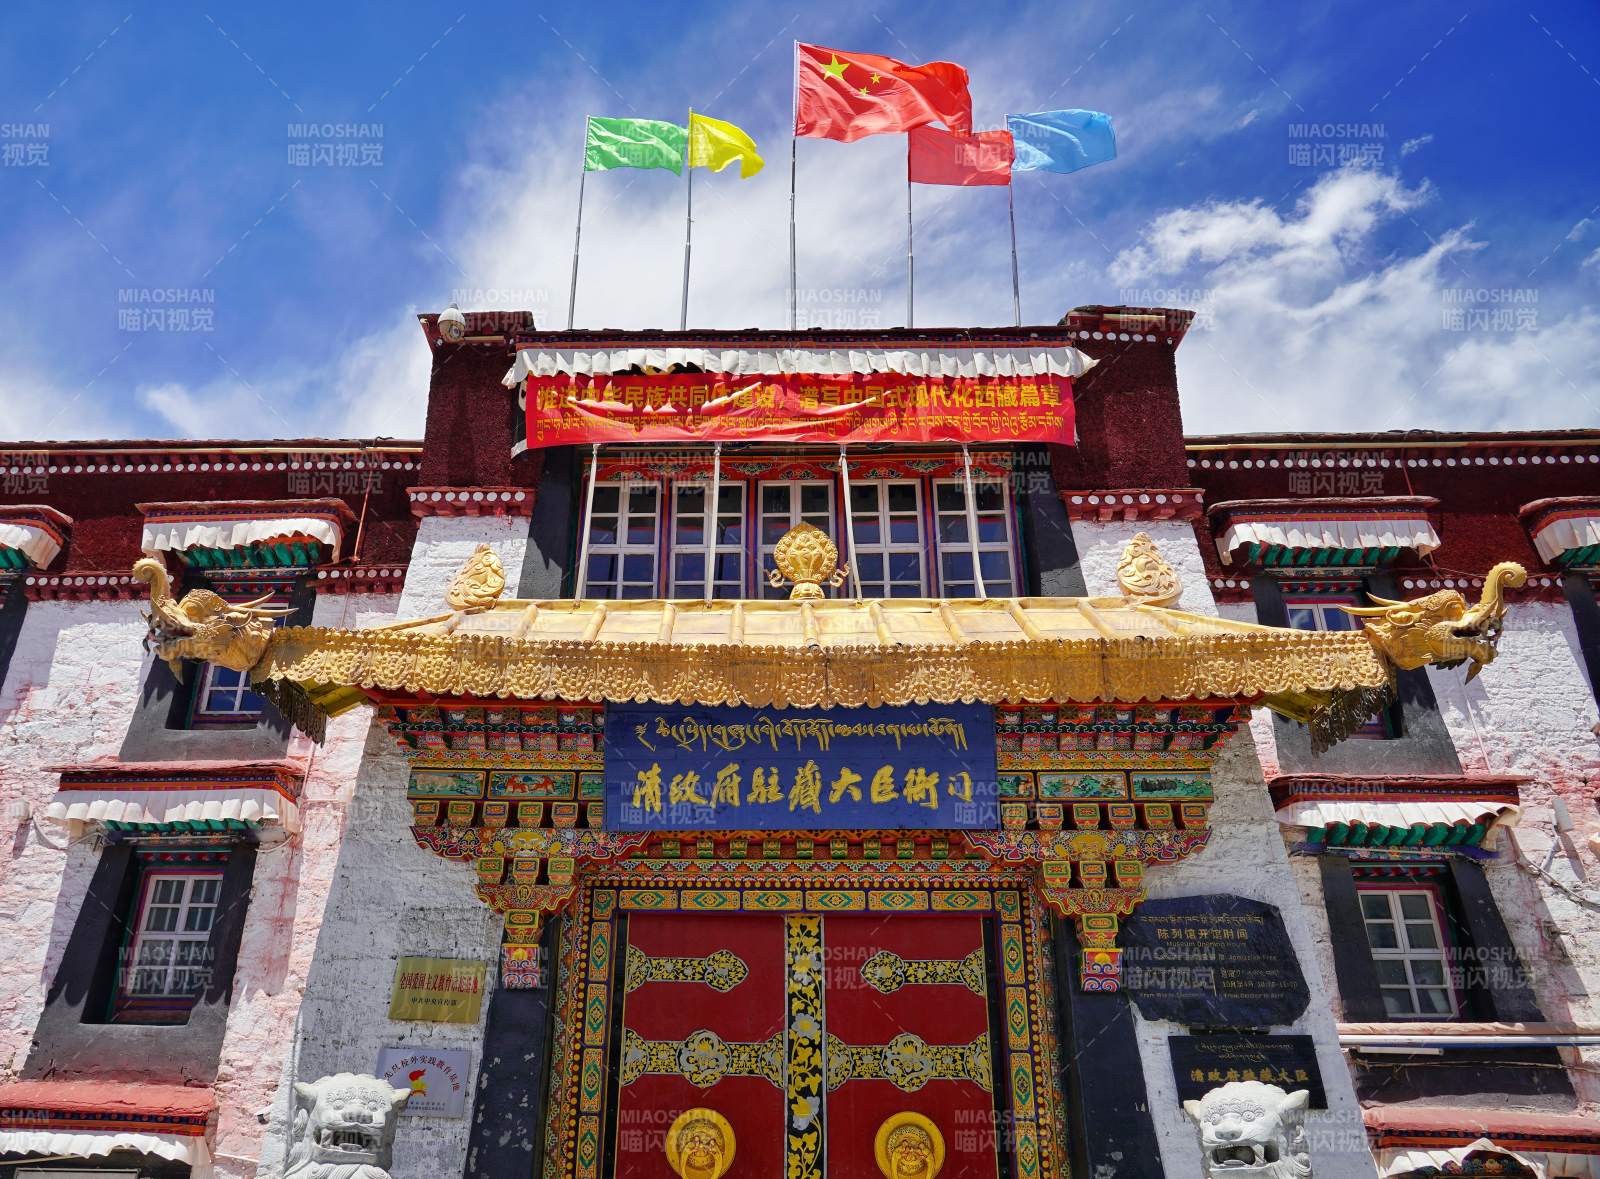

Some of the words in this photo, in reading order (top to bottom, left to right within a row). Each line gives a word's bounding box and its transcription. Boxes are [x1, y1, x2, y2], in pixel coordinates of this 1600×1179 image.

[1157, 928, 1248, 940] 陈列馆开馆时间
